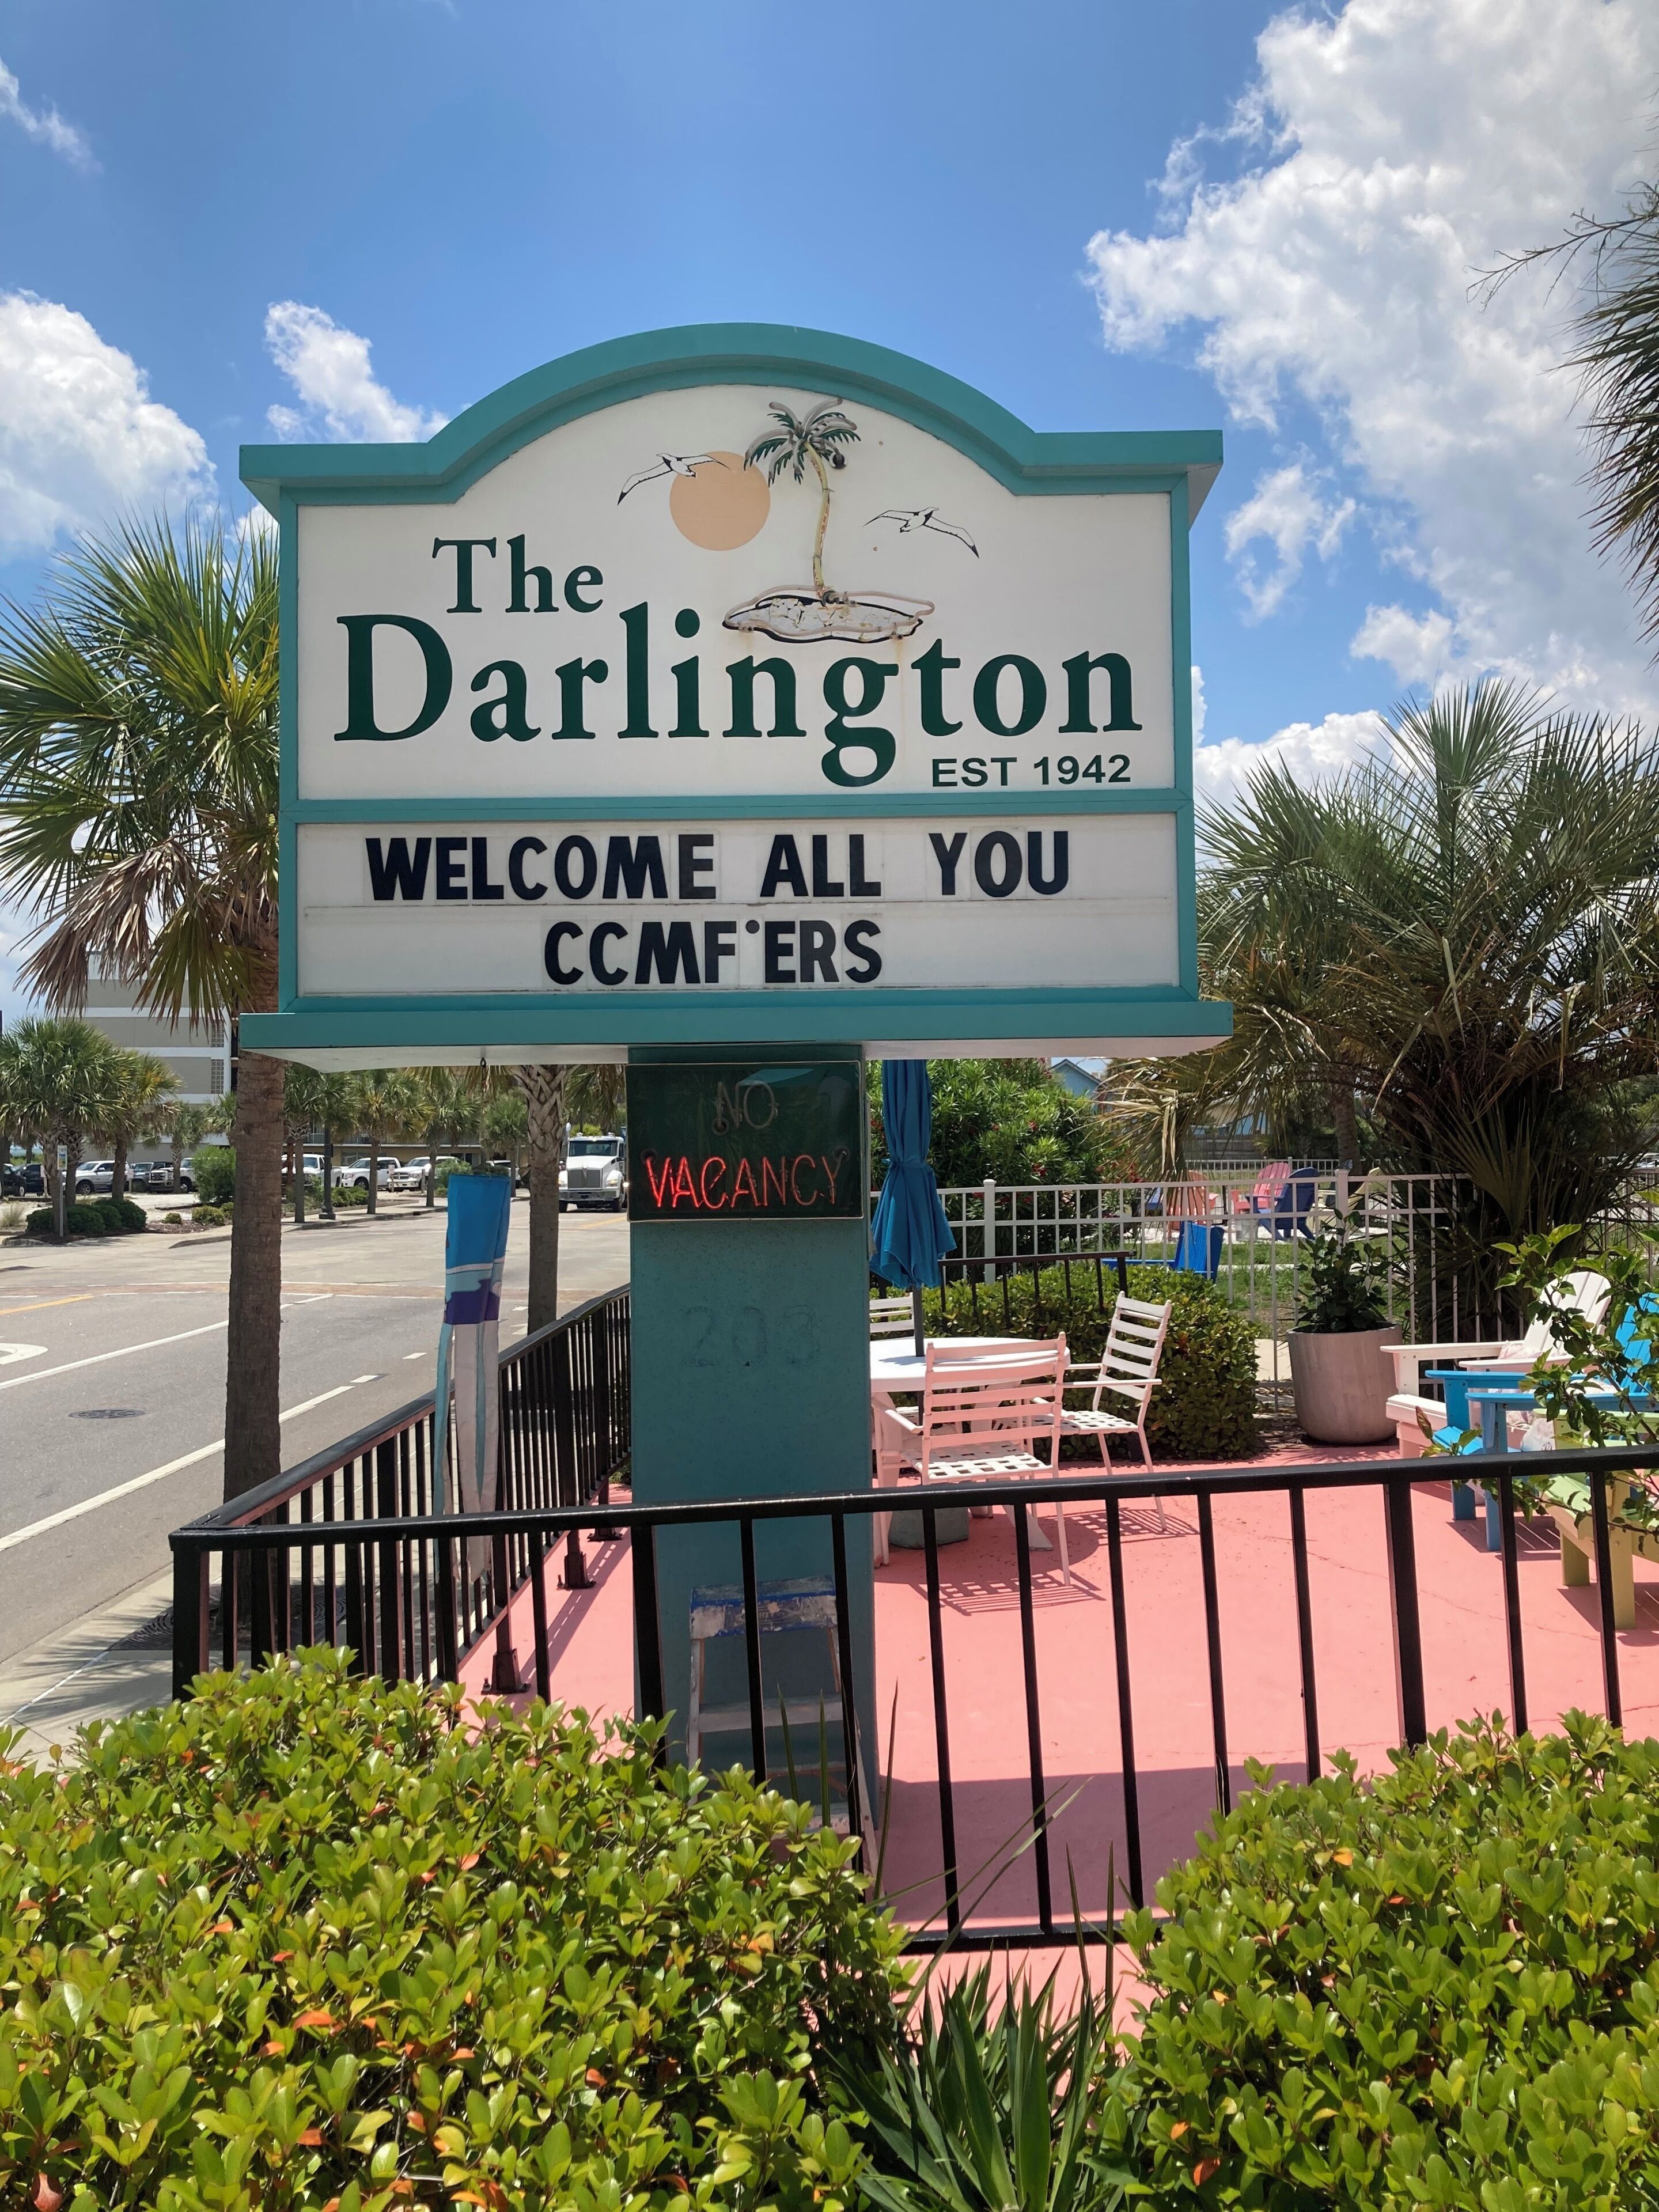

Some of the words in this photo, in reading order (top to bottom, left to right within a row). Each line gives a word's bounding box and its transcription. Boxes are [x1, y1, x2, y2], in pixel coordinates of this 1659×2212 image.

[432, 534, 603, 613] The
[334, 600, 1143, 787] Darlington
[933, 757, 1017, 787] EST
[1033, 754, 1131, 785] 1942
[365, 834, 717, 901] WELCOME
[760, 834, 882, 897] ALL
[929, 831, 1069, 898] YOU
[715, 1081, 778, 1130] NO
[645, 1153, 847, 1209] VACANCY
[684, 1305, 822, 1366] 203
